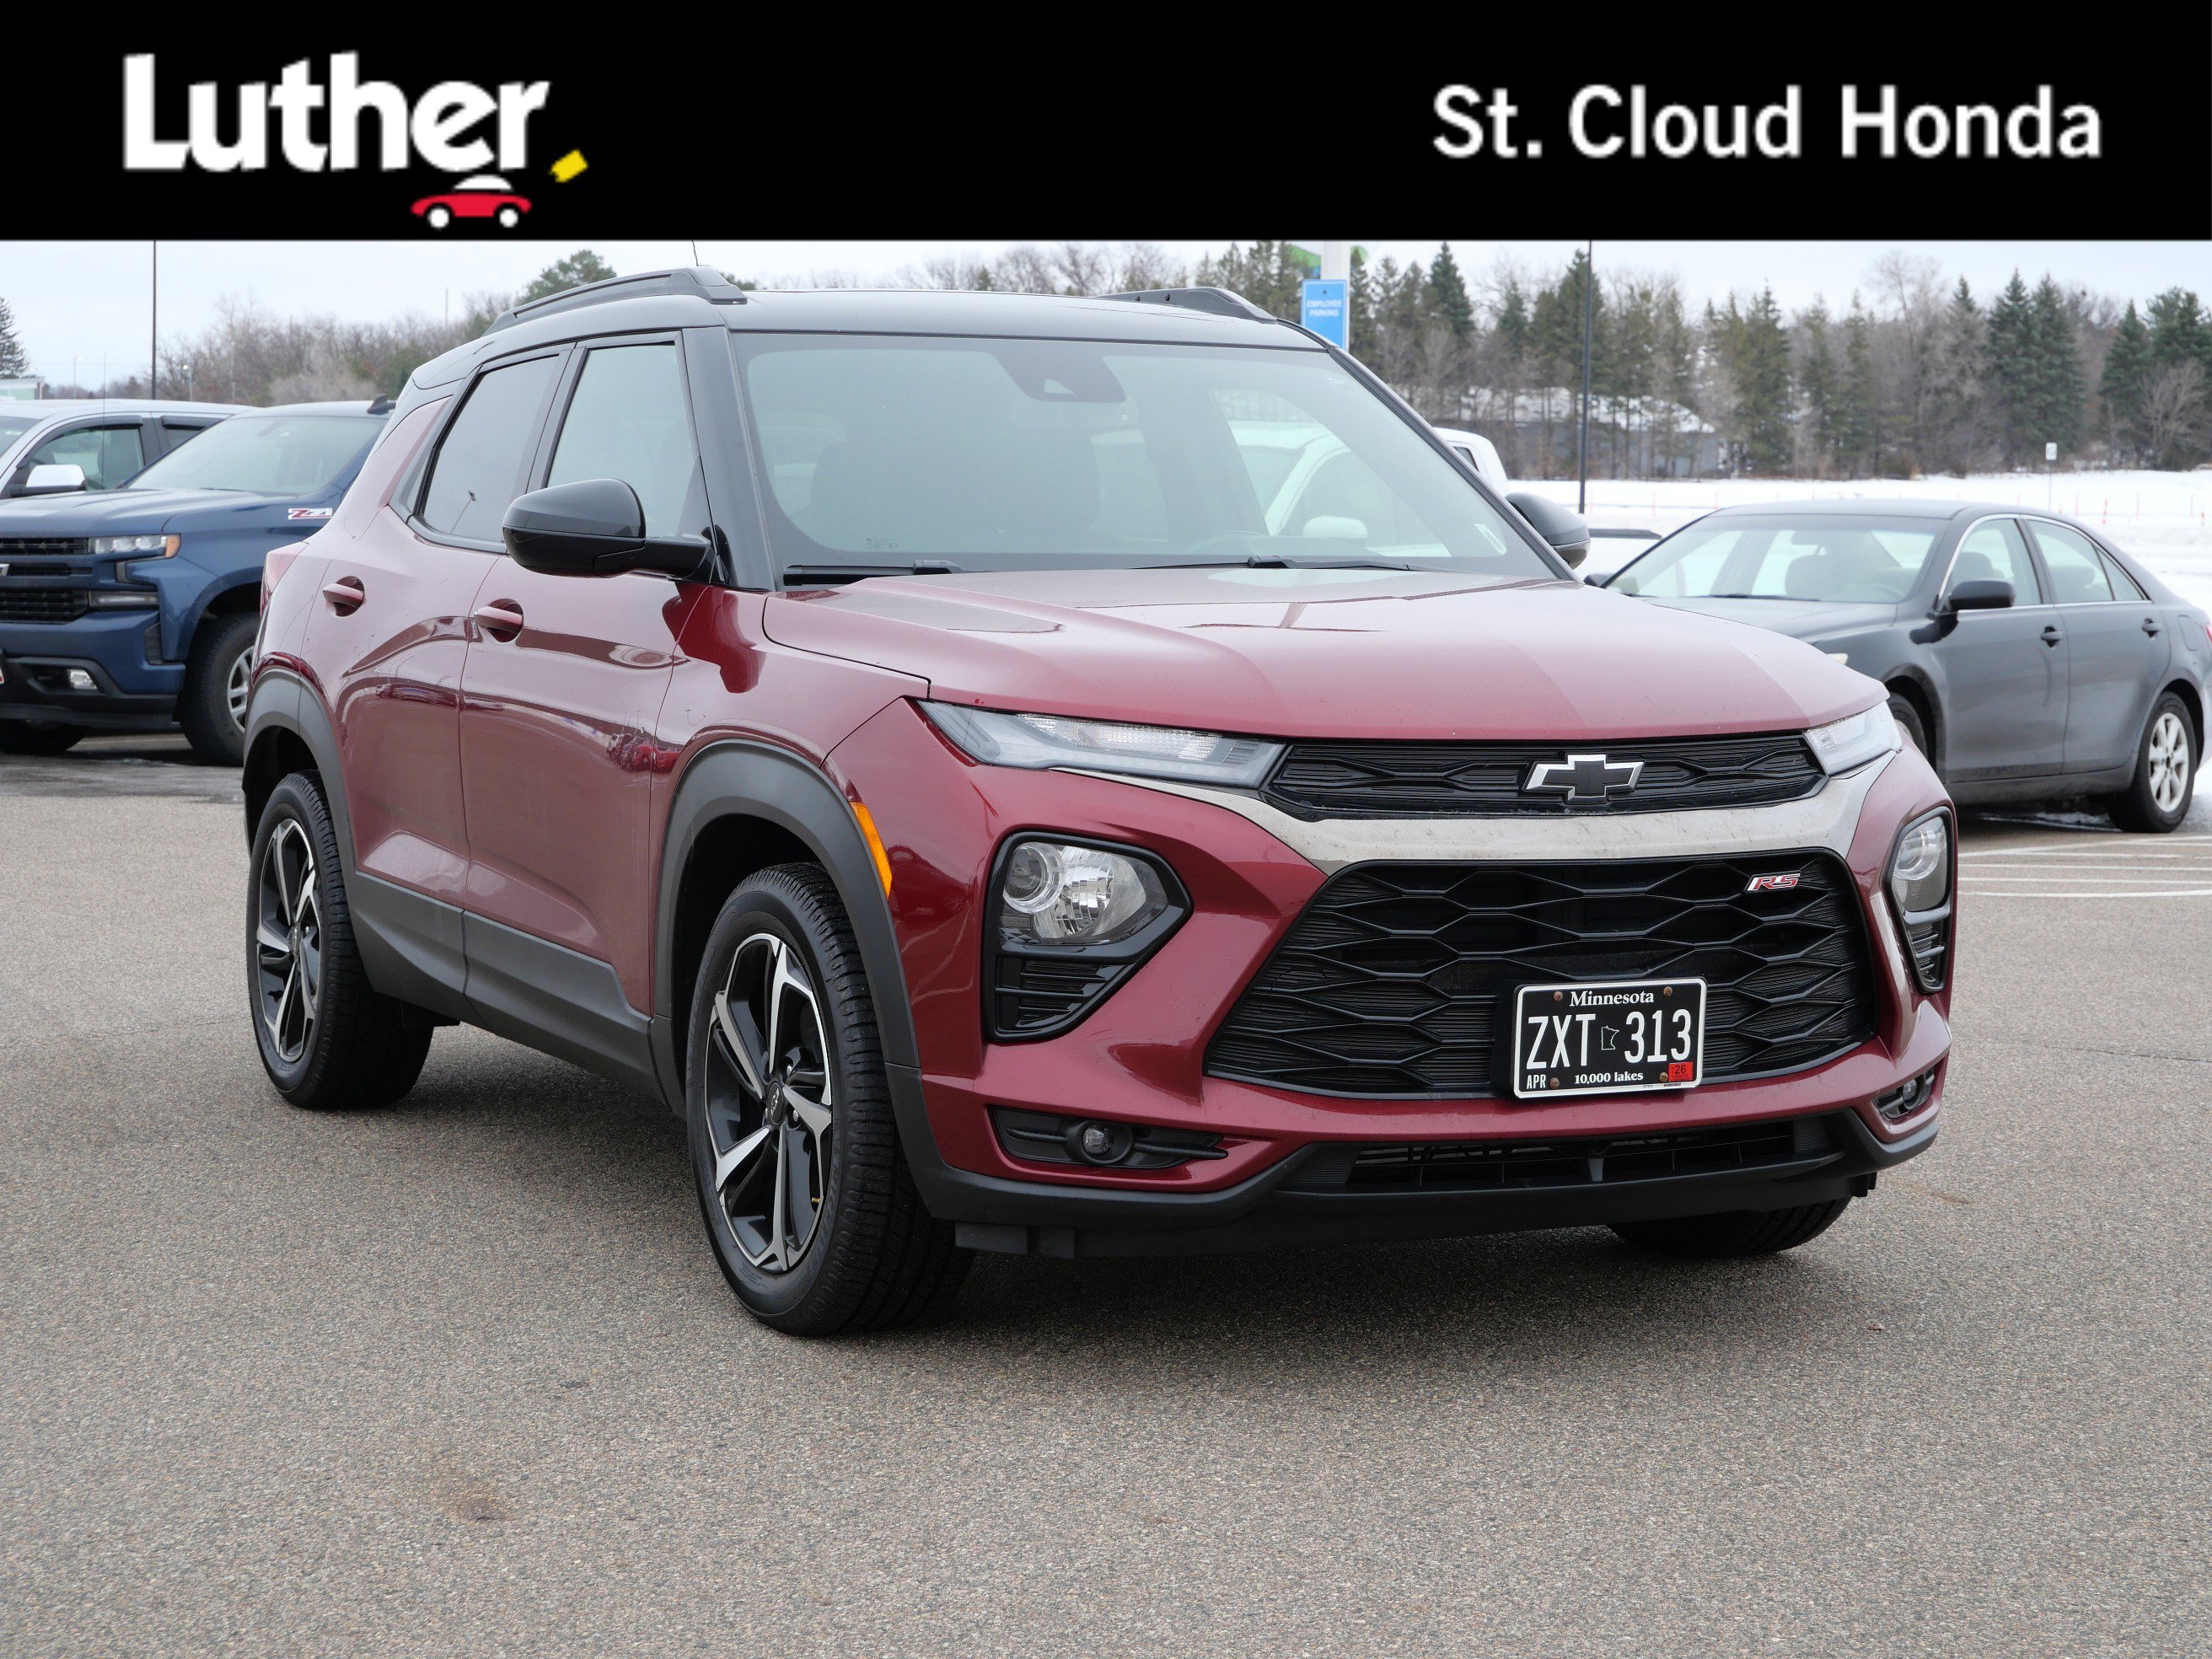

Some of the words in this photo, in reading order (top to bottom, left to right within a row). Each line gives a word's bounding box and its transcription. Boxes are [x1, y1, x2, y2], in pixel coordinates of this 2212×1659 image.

[1309, 309, 1340, 317] PARKING
[1748, 873, 1801, 891] RS
[1569, 990, 1655, 1007] Minnesota
[1526, 1013, 1597, 1070] ZXT
[1624, 1008, 1692, 1064] 313
[1674, 1065, 1687, 1075] 26
[1526, 1074, 1547, 1089] APR
[1574, 1073, 1611, 1085] 10,000
[1613, 1071, 1644, 1083] lakes
